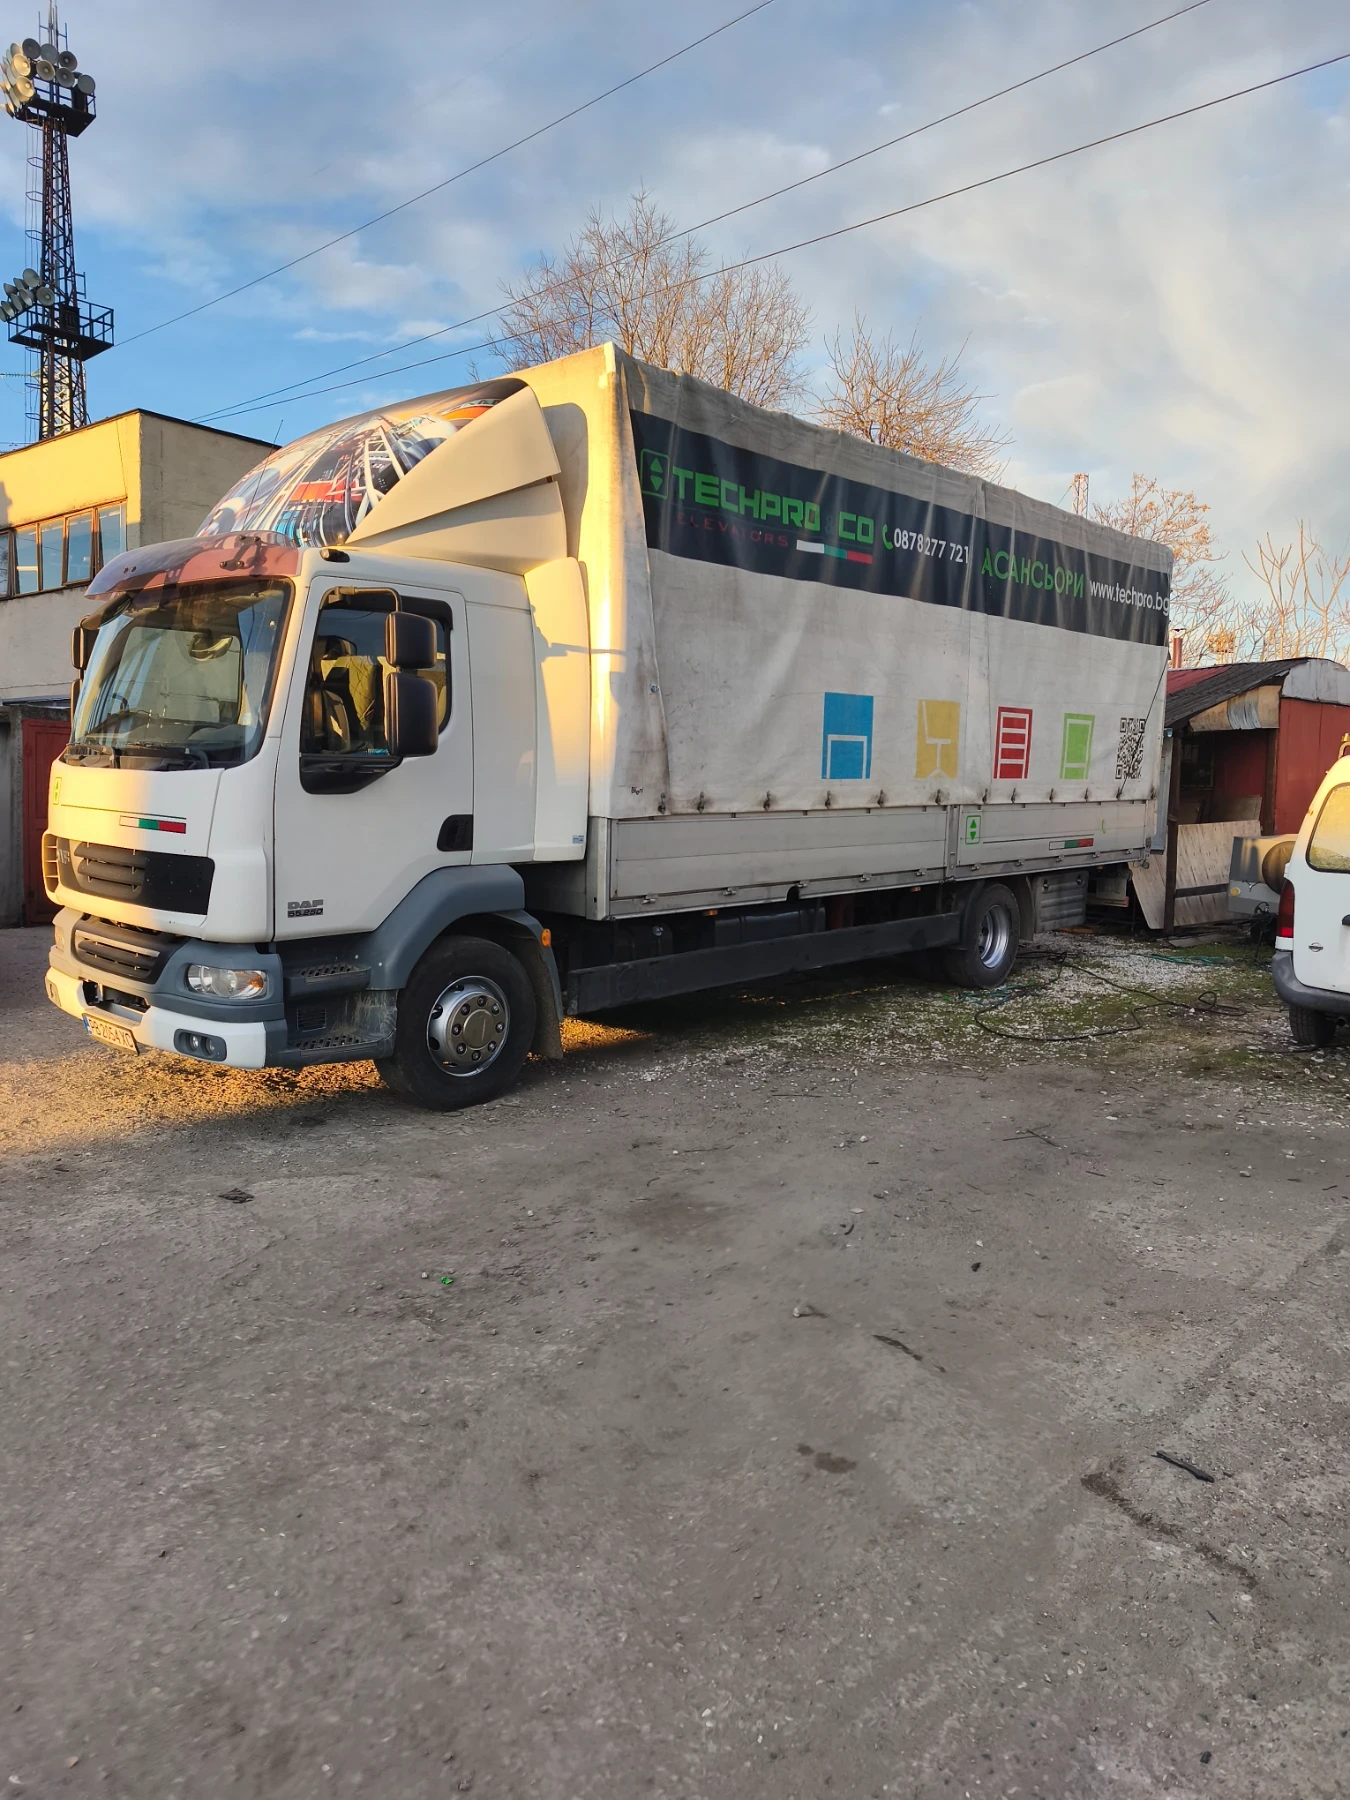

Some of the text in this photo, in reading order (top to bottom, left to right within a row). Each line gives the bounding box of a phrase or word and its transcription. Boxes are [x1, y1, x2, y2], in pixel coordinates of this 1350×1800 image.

[671, 465, 821, 532] TECHPRO
[838, 510, 875, 545] CO
[675, 511, 789, 548] ELEVATORS
[949, 542, 969, 565] 721
[981, 547, 1085, 599] АСАНСЬОРИ
[1089, 580, 1171, 617] www.techpro.bg
[287, 899, 324, 910] DAF
